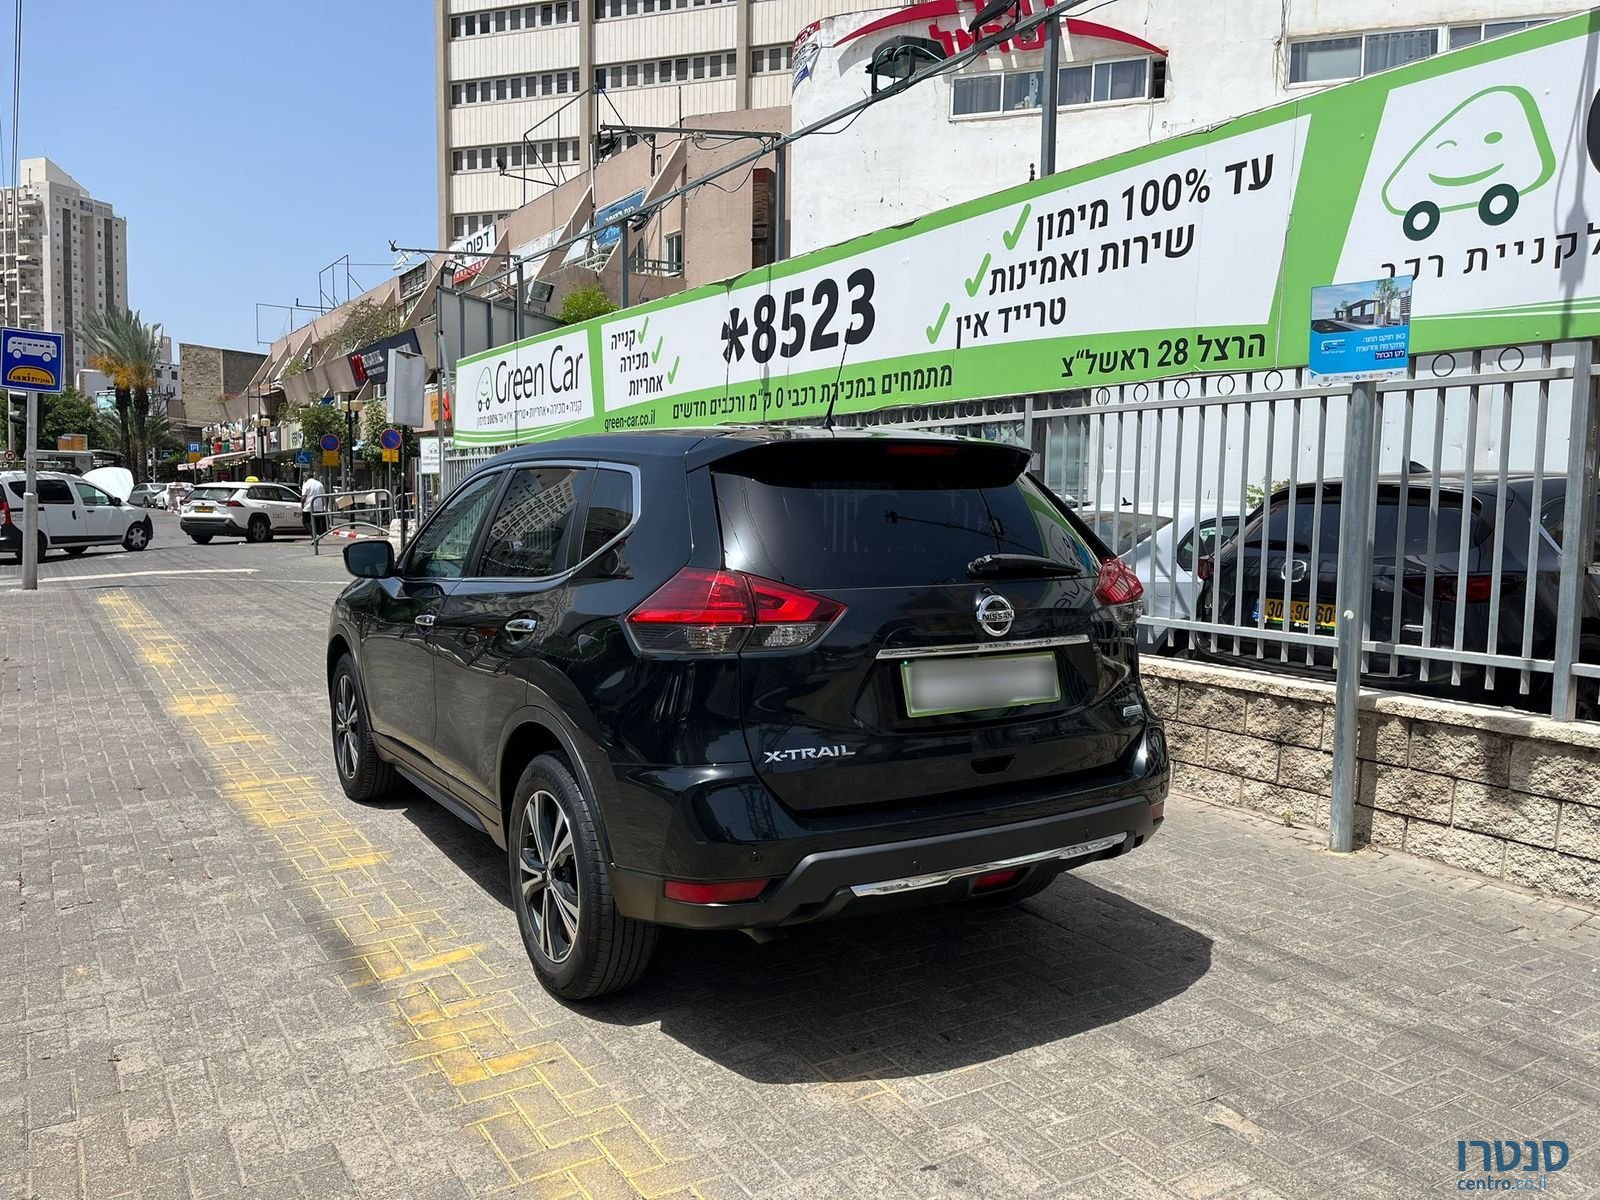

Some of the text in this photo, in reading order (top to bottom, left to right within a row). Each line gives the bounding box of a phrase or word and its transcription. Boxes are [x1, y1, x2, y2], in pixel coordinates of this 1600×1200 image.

[1036, 154, 1274, 251] עד 100% מימון
[989, 224, 1195, 296] שירות ואמינות
[956, 296, 1066, 349] טרייד אין
[612, 328, 636, 352] קנייה
[1196, 333, 1266, 362] הרצל
[620, 352, 649, 373] מכירה
[1157, 338, 1188, 367] 28
[496, 345, 583, 403] Green Car
[628, 374, 663, 397] אחריות
[881, 364, 952, 394] מתמחים
[776, 386, 783, 408] 0
[788, 386, 816, 406] רכבי
[820, 378, 876, 403] במכירת
[673, 400, 706, 420] חדשים
[710, 393, 746, 416] ורכבים
[604, 409, 656, 432] green-car.co.il
[982, 610, 1013, 620] NISSAN
[764, 744, 856, 764] X-TRAIL
